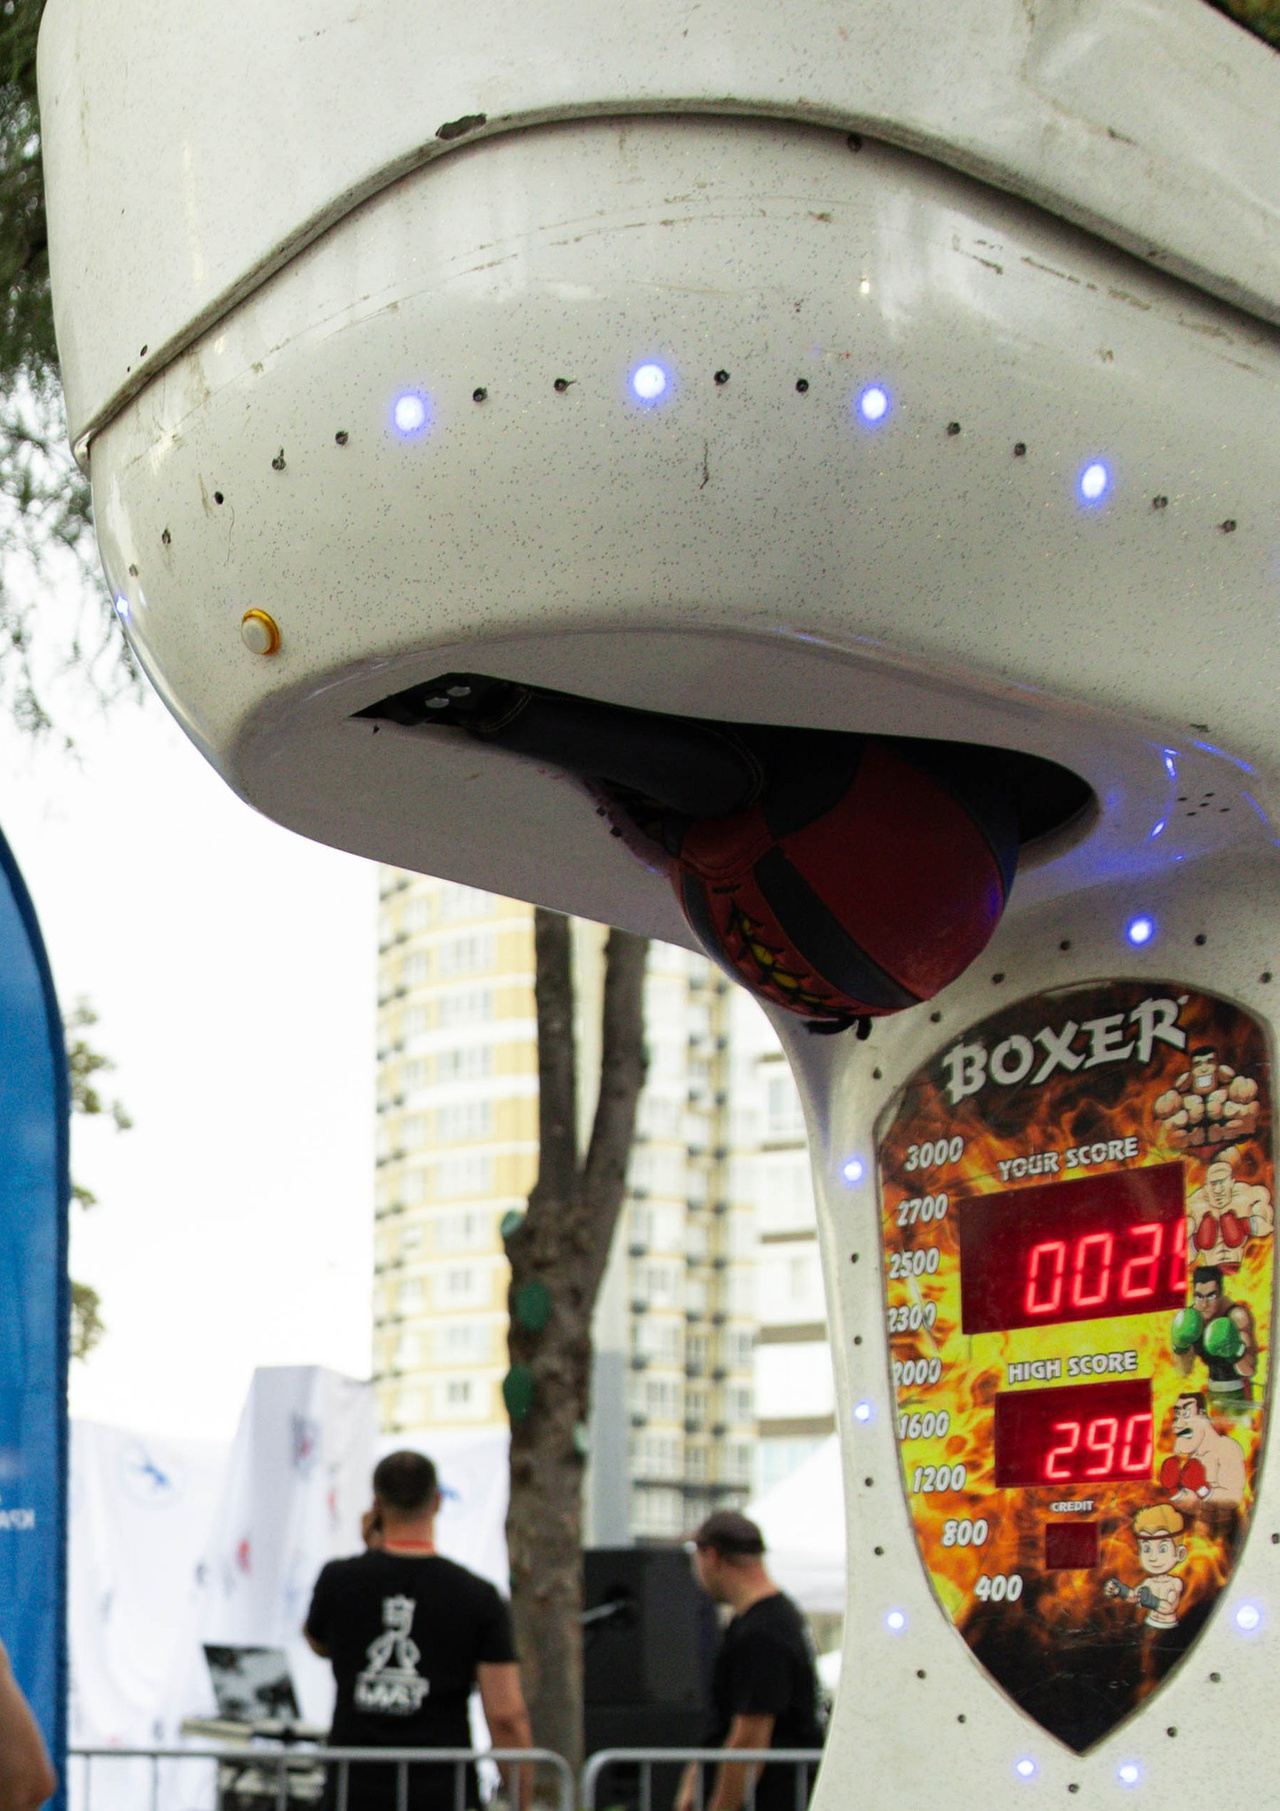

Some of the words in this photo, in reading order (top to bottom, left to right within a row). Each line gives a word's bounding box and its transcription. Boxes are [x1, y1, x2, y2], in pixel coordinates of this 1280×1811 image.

[942, 994, 1187, 1104] BOXER
[904, 1136, 964, 1172] 3000
[998, 1151, 1060, 1182] YOUR
[1066, 1136, 1139, 1170] SCORE
[896, 1194, 949, 1228] 2700
[889, 1247, 940, 1280] 2500
[887, 1301, 937, 1333] 2300
[893, 1357, 942, 1387] 2000
[1007, 1358, 1061, 1386] HIGH
[1067, 1350, 1138, 1377] SCORE
[899, 1409, 950, 1441] 1600
[912, 1463, 967, 1494] 1200
[1050, 1499, 1094, 1514] CREDIT
[941, 1518, 989, 1548] 800
[974, 1574, 1023, 1603] 400
